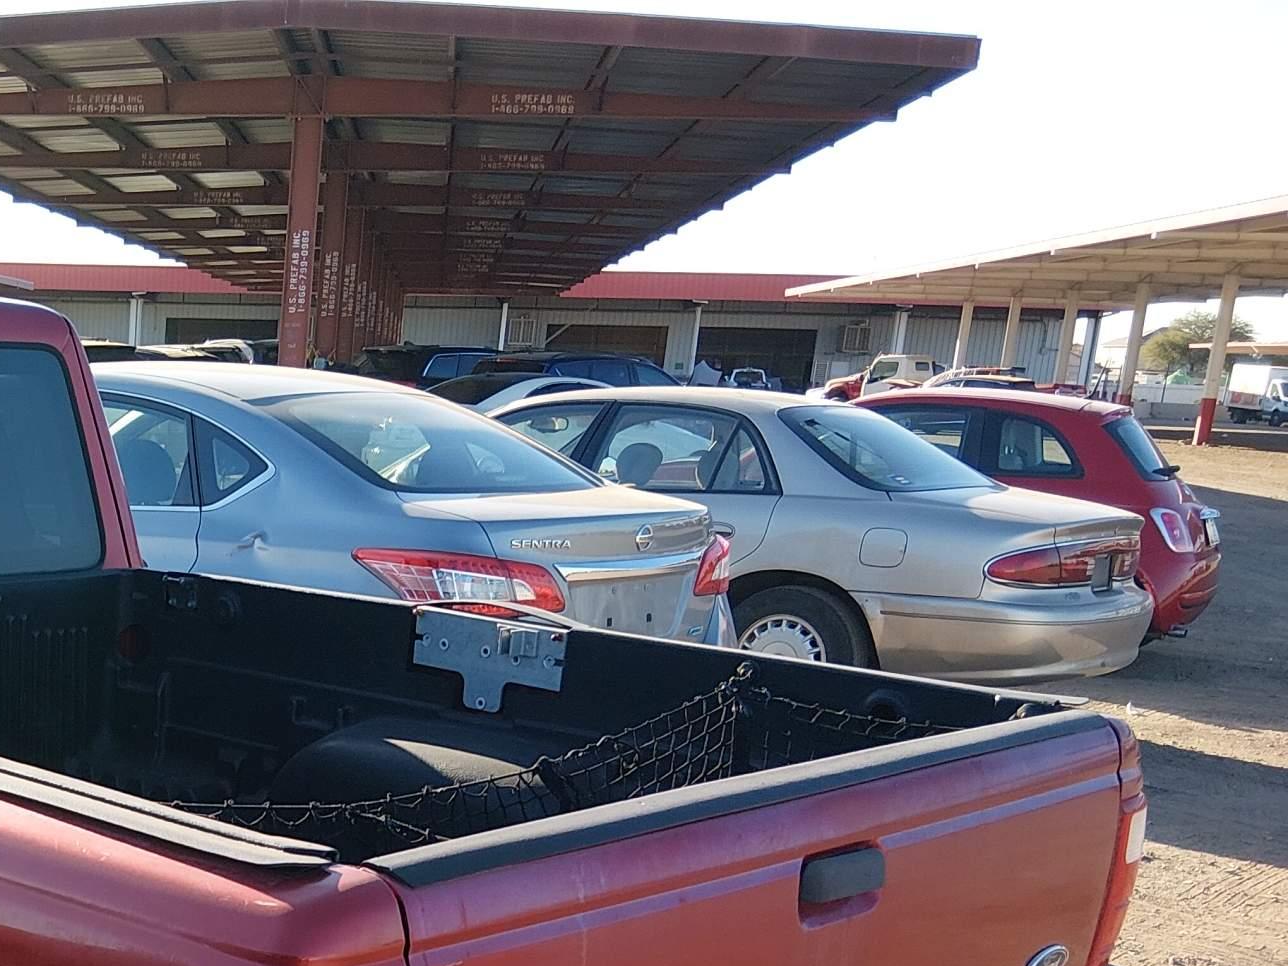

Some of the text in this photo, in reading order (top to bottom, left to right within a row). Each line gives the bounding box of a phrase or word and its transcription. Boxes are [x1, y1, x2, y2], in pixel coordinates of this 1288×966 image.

[89, 94, 124, 103] PREFAB
[492, 94, 510, 104] U.S.
[515, 94, 552, 103] PREFAB
[292, 229, 302, 249] INC.
[290, 252, 300, 290] PREFAB
[297, 230, 310, 312] 1-866-799-0969
[288, 296, 298, 314] U.S.
[511, 538, 573, 550] SENTRA
